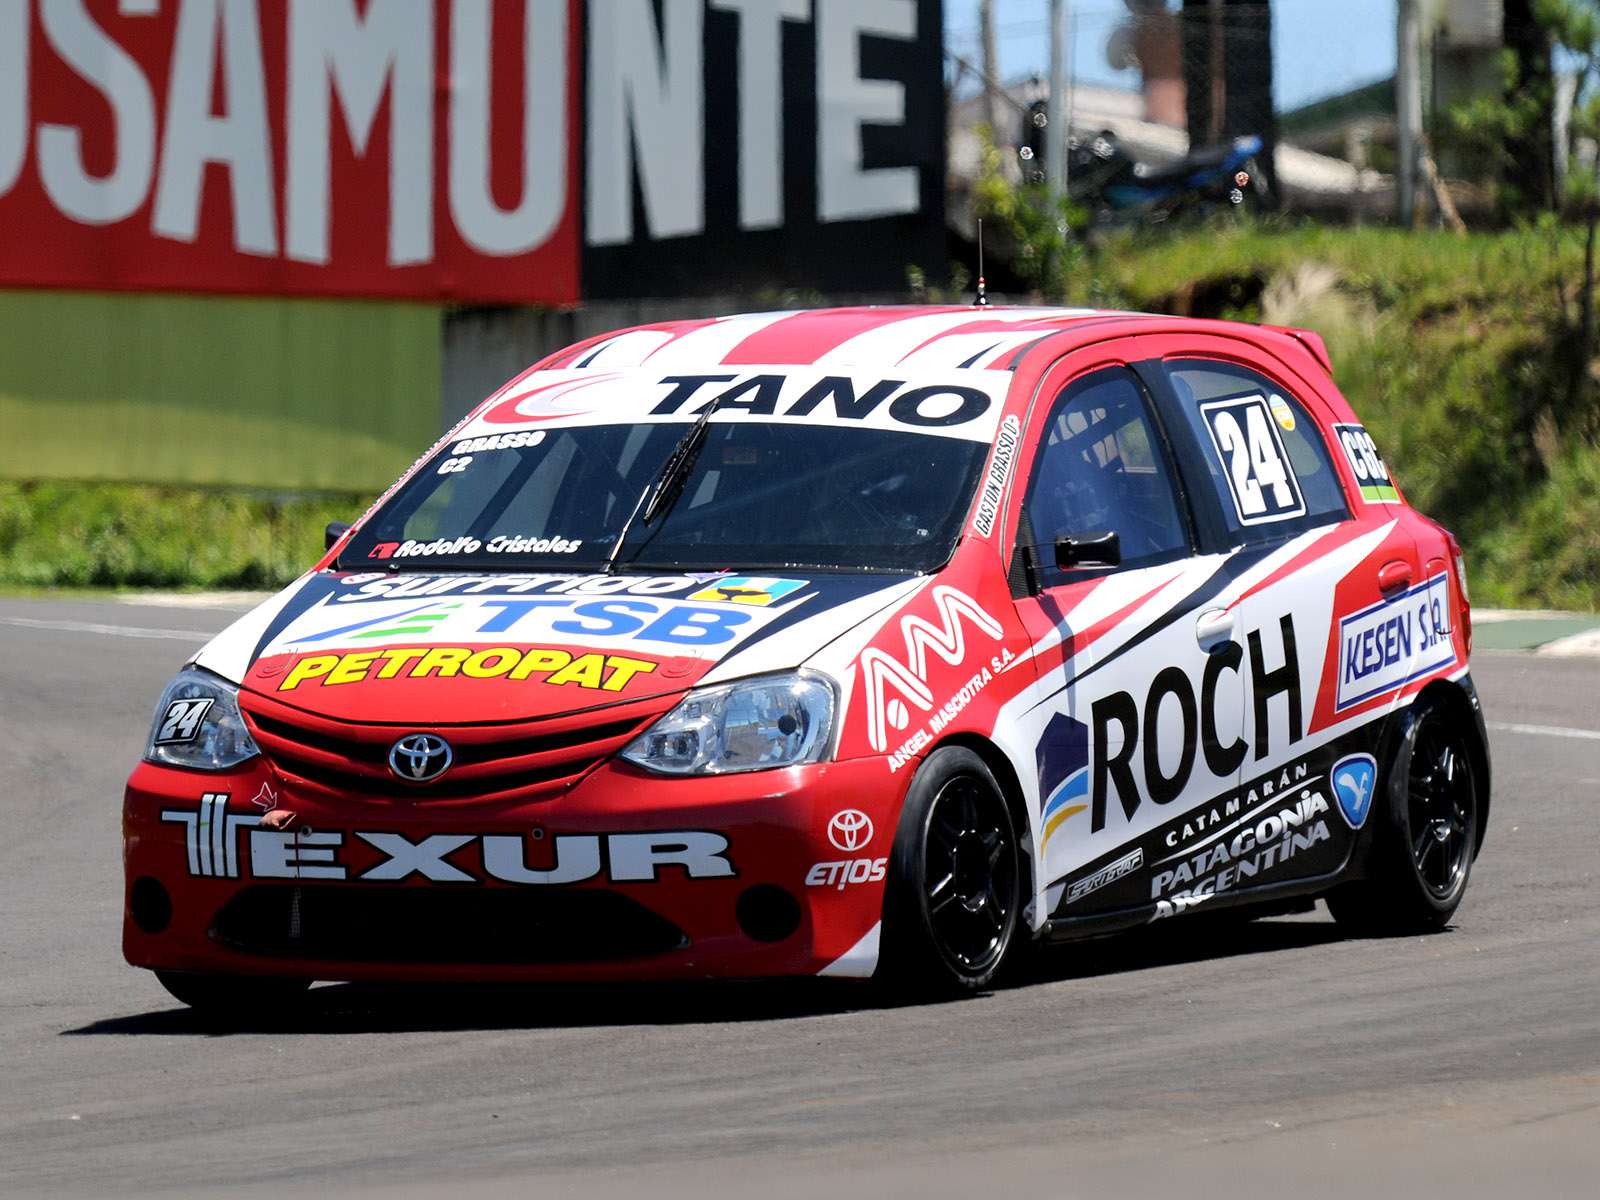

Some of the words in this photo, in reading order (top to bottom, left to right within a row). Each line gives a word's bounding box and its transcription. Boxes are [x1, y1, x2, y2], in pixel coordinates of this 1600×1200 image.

[648, 375, 992, 428] TANO
[437, 456, 473, 475] C2
[451, 430, 547, 455] GRASSO
[1213, 404, 1294, 515] 24
[975, 481, 1001, 536] GASTON
[990, 431, 1016, 485] GRASSO
[393, 536, 482, 558] Rodolfo
[475, 600, 752, 645] TSB
[1345, 610, 1412, 684] KESEN
[278, 647, 657, 692] PETROPAT
[158, 701, 206, 740] 24
[887, 728, 934, 773] ANGEL
[928, 667, 993, 734] MASCIOTRA
[991, 647, 1016, 673] S.A.
[1090, 612, 1304, 834] ROCH
[1165, 762, 1308, 847] CATAMARÁN
[804, 857, 888, 891] ETIOS
